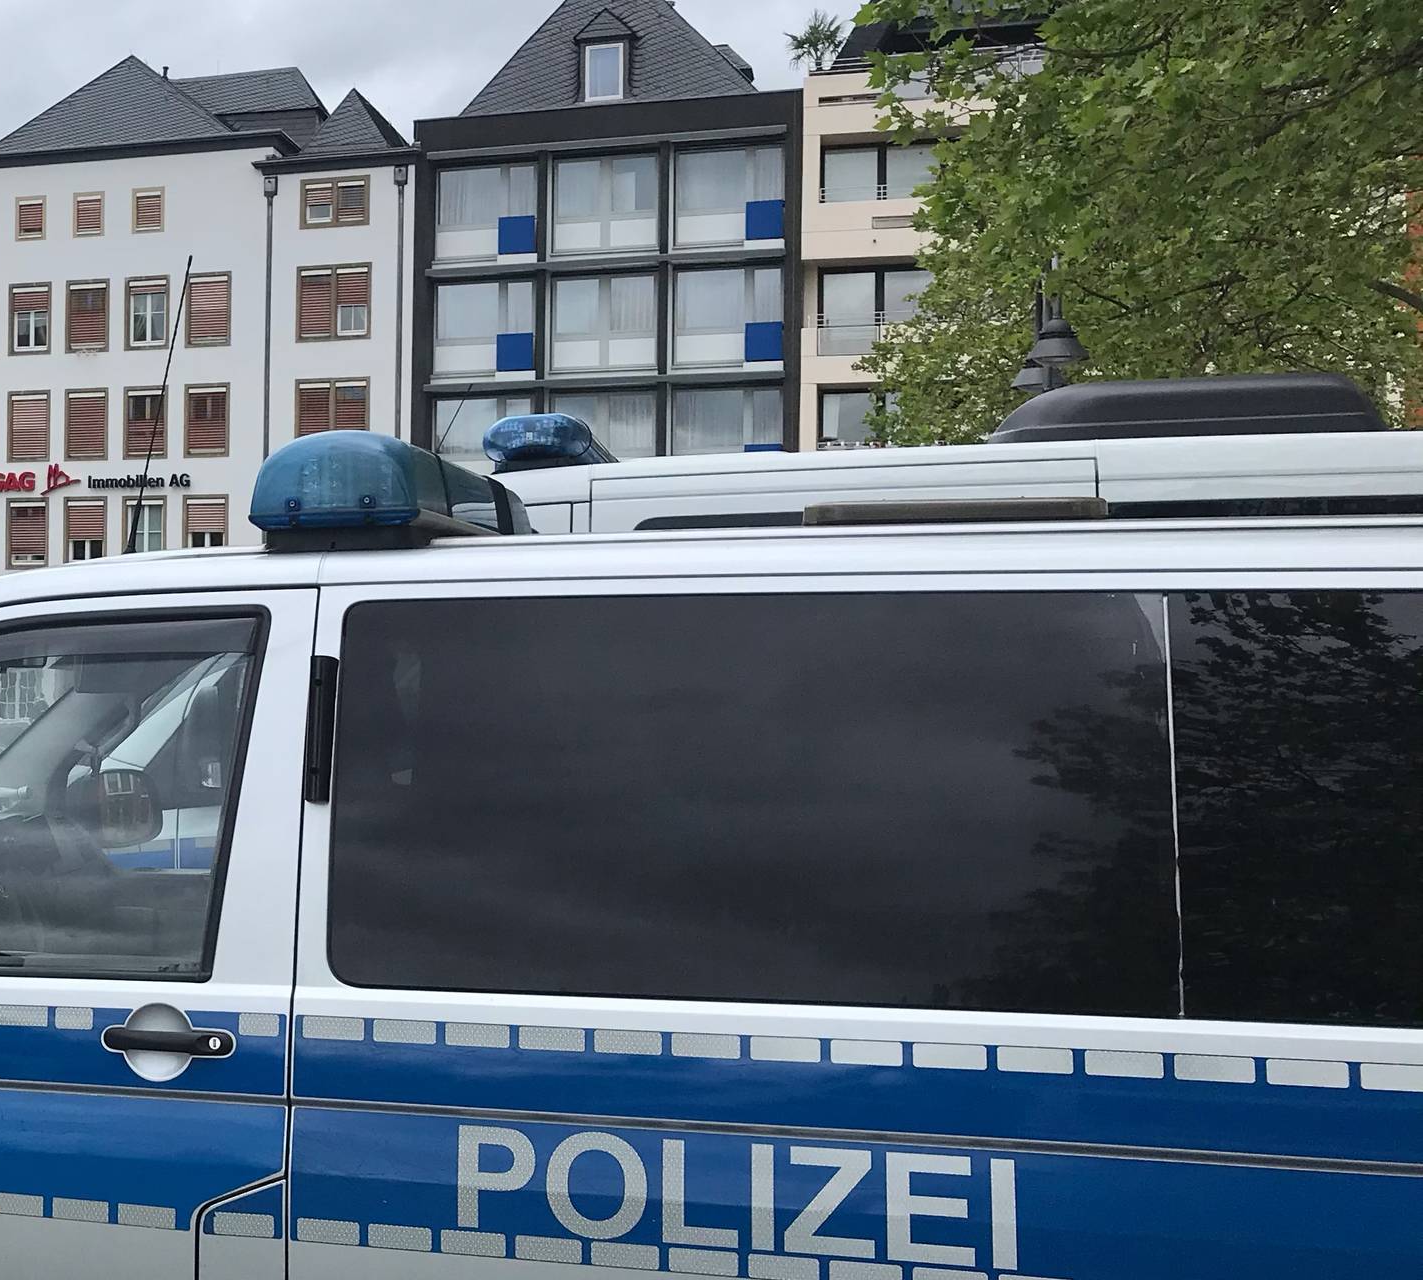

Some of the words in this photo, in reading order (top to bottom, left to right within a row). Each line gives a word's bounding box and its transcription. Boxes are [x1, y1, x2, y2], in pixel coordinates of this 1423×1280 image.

[87, 474, 165, 489] Immobilien
[169, 473, 191, 488] AG
[457, 1124, 1017, 1270] POLIZEI
